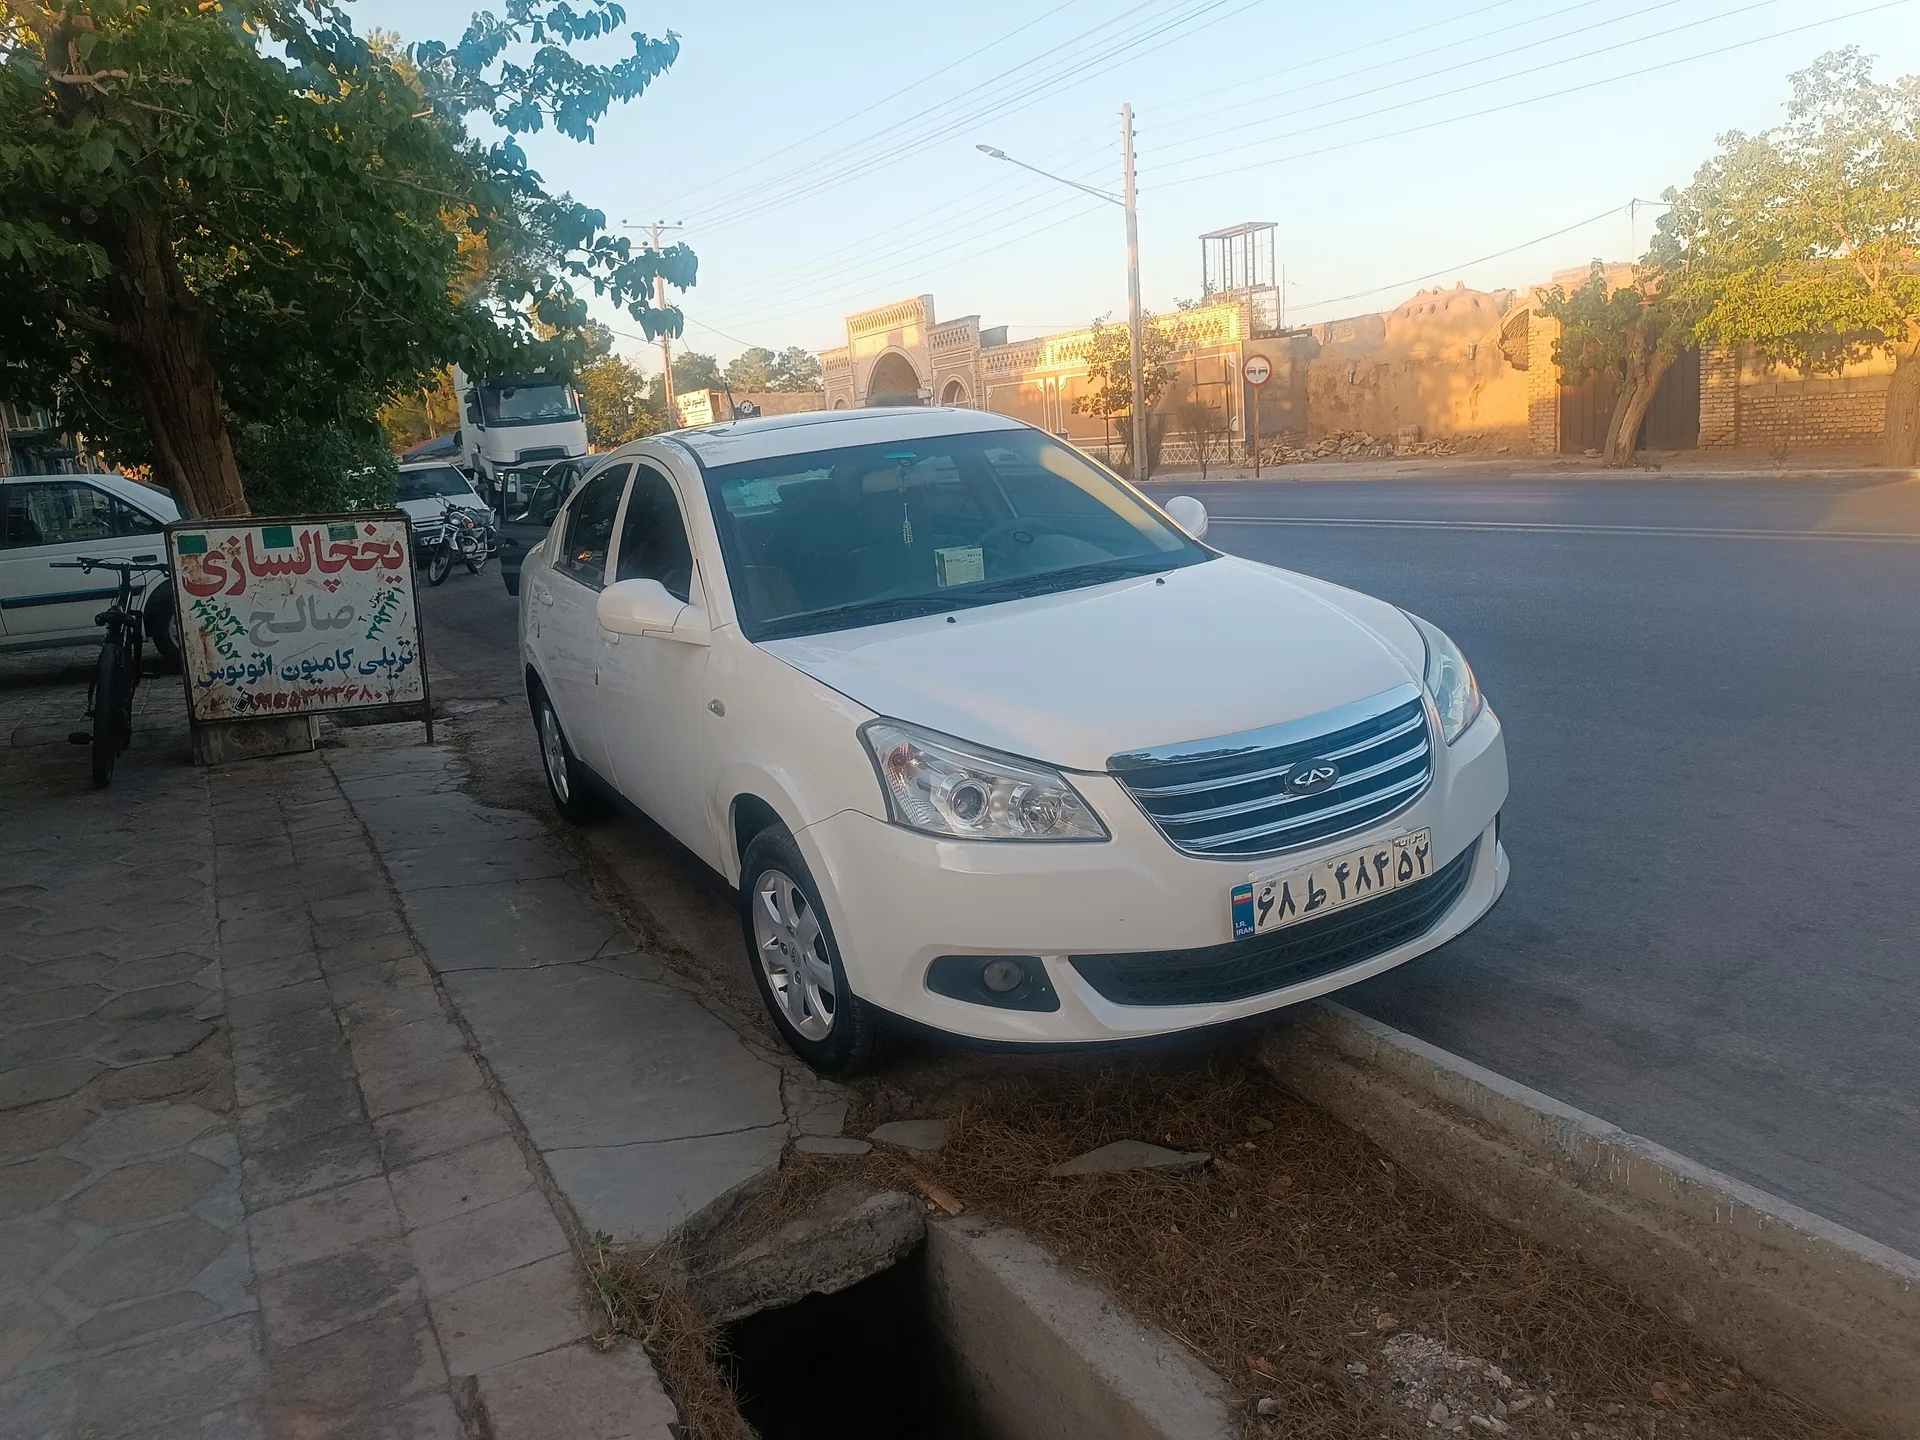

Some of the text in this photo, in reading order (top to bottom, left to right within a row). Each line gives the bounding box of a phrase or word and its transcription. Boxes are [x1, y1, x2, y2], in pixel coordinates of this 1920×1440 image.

[182, 523, 405, 597] یخچالسازی
[248, 594, 356, 648] صالح
[197, 636, 418, 691] تریلی کامیون اتوبوس
[1396, 832, 1426, 849] ایران
[1236, 926, 1254, 937] IRAN
